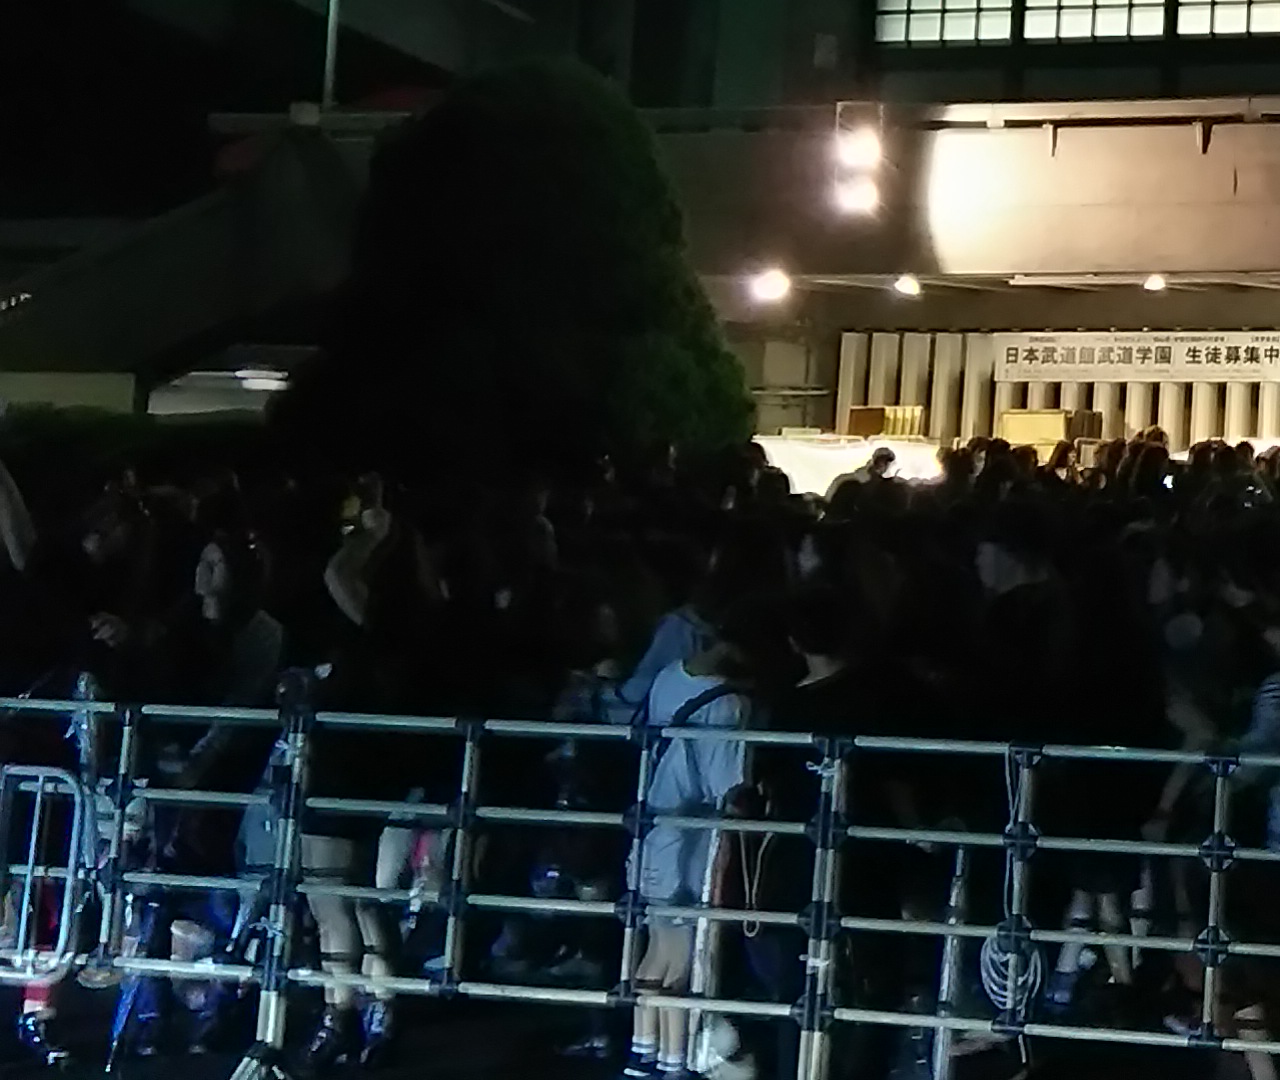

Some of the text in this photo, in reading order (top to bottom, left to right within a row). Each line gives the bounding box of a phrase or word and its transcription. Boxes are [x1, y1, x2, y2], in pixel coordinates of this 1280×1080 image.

[1185, 345, 1280, 364] 生徒募集中
